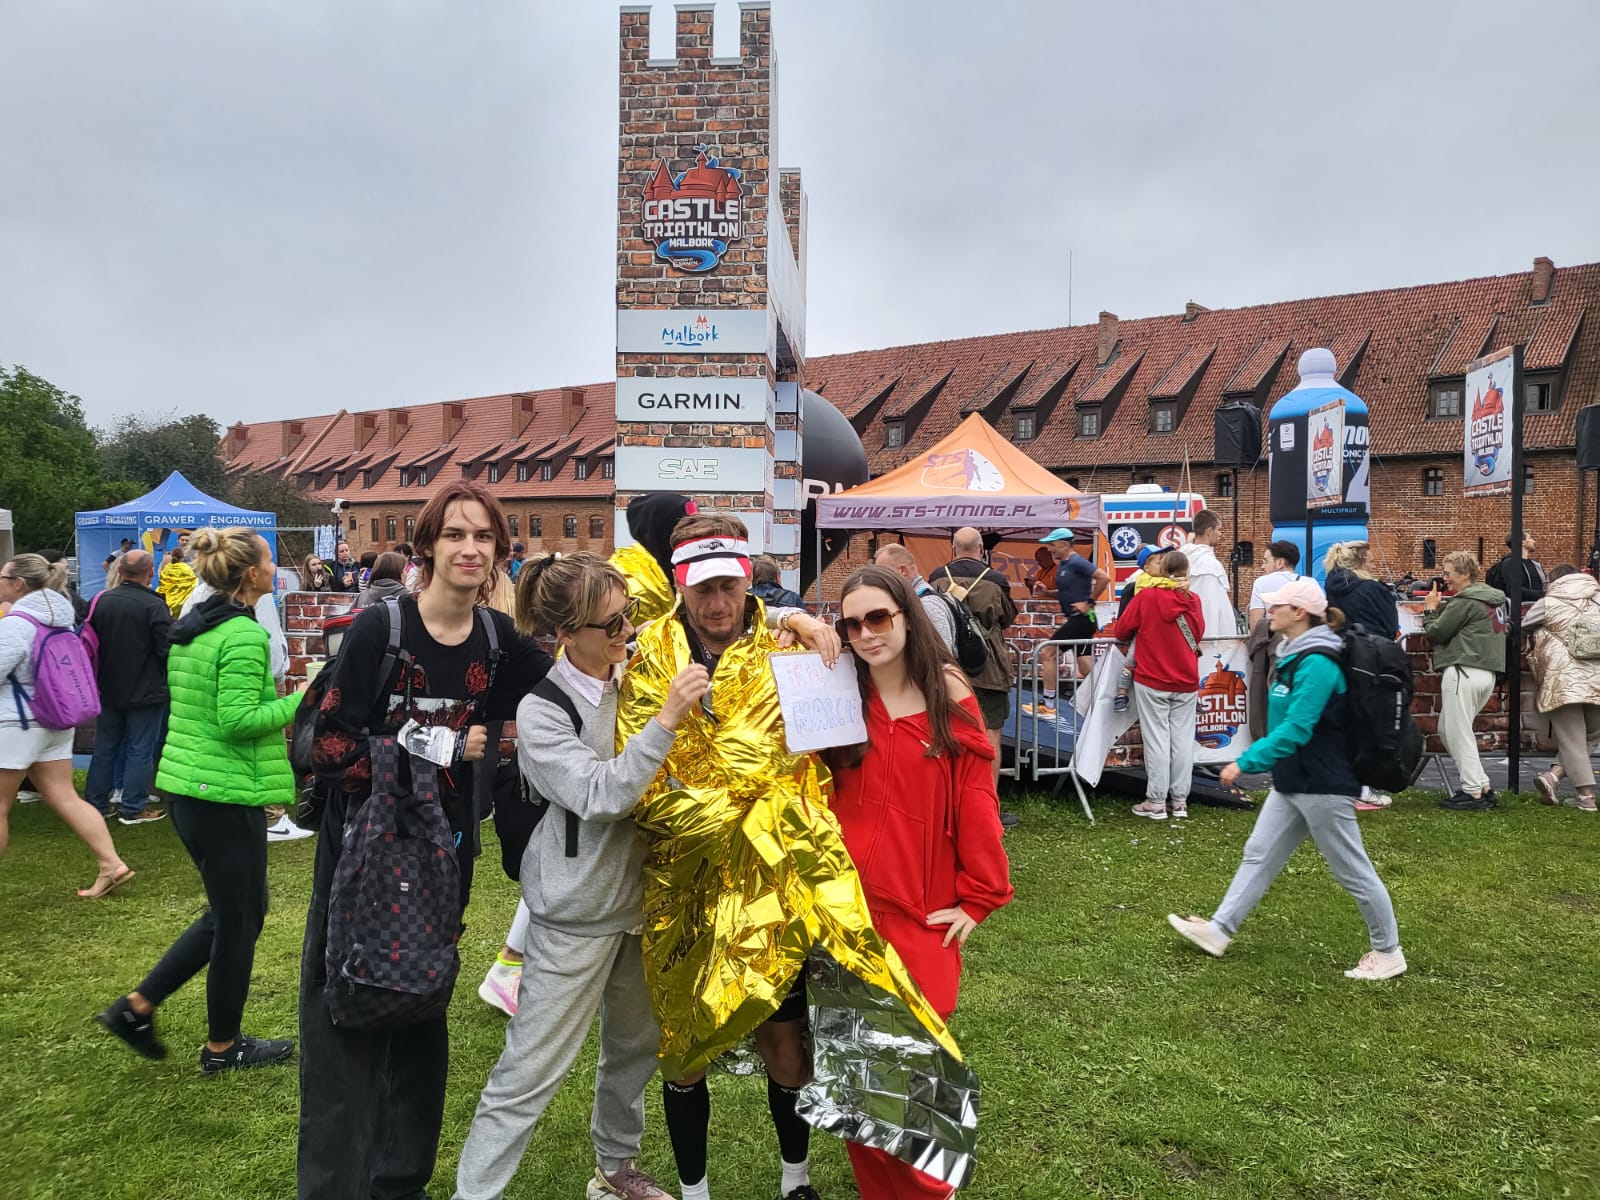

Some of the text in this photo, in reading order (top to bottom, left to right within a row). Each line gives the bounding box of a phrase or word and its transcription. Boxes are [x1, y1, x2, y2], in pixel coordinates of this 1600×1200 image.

[644, 199, 739, 220] CASTLE
[644, 221, 739, 237] TRIATHLON
[669, 238, 714, 248] MALBORK
[662, 325, 720, 342] Malbork
[638, 393, 740, 410] GARMIN
[1472, 413, 1503, 437] CASTLE
[924, 450, 963, 468] STS
[658, 458, 718, 480] SAE
[144, 515, 272, 525] GRAWER ENGRAVING
[833, 505, 1037, 519] WWW.STS-TIMING.PL
[1198, 693, 1246, 711] STLE
[1196, 711, 1246, 725] IATHLON
